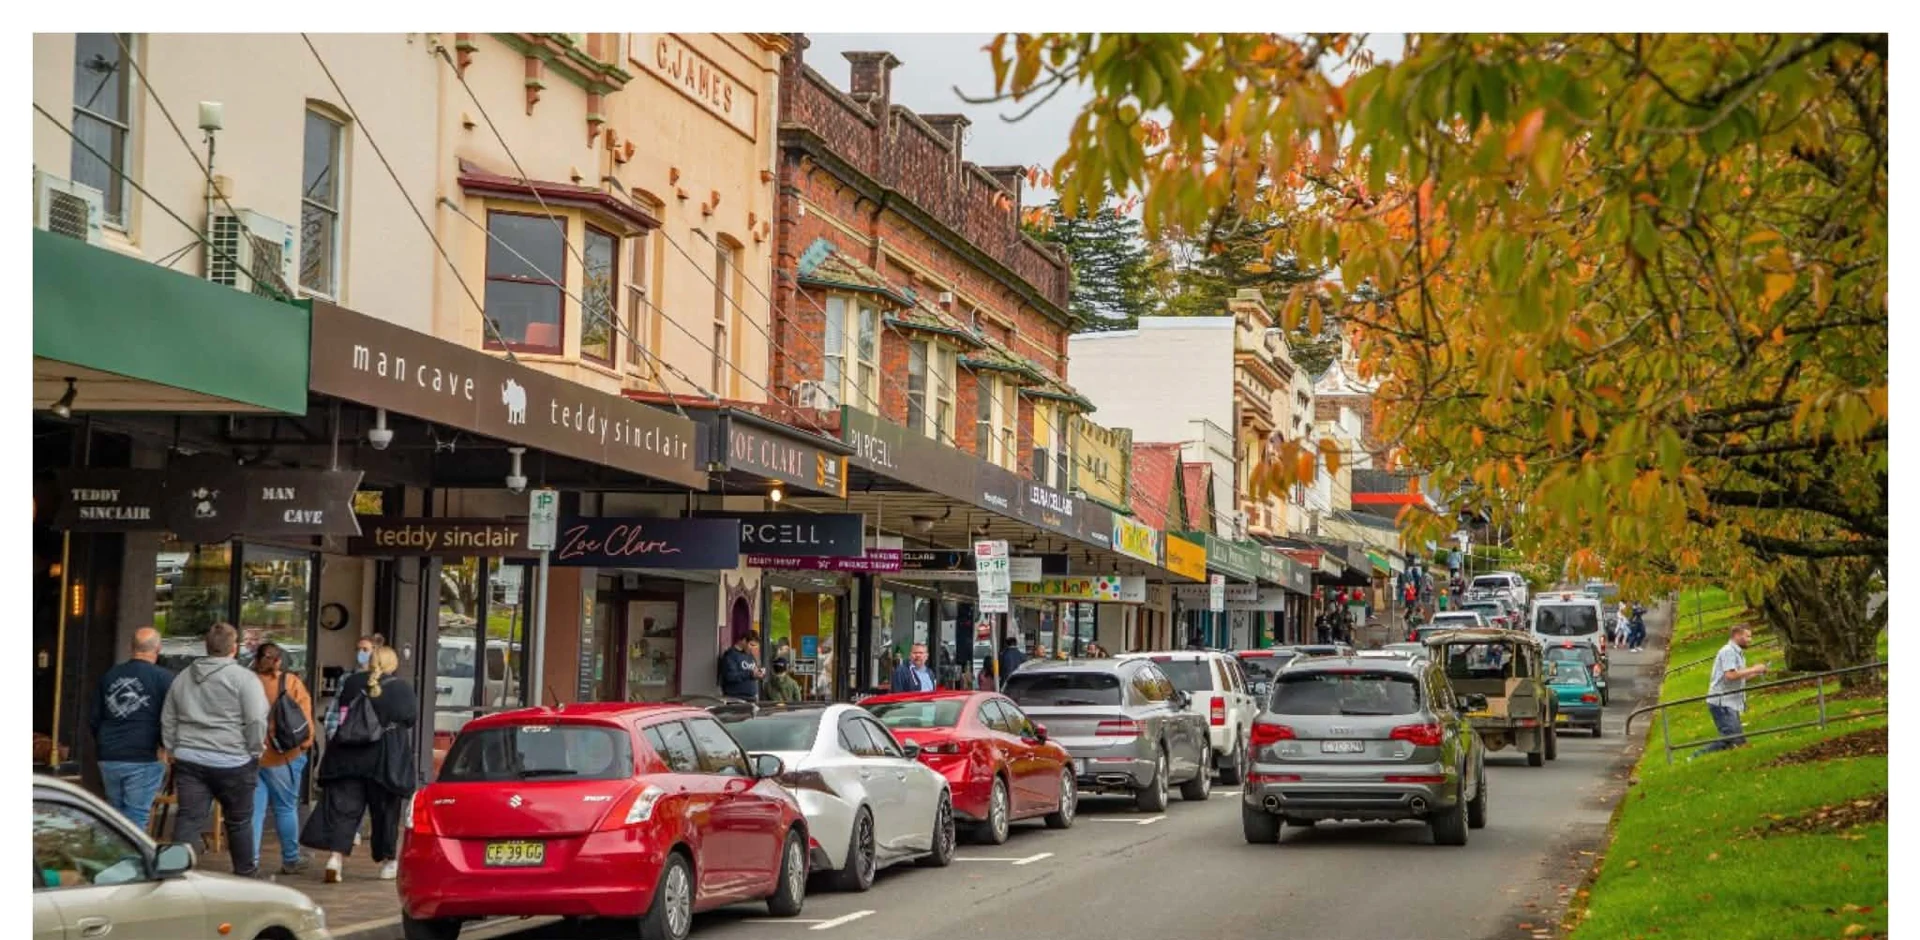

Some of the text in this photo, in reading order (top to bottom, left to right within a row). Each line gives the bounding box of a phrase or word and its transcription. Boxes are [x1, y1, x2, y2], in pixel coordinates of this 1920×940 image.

[353, 344, 475, 401] man cave
[550, 398, 688, 460] teddy sinclair
[71, 488, 121, 502] TEDDY
[262, 486, 296, 501] MAN
[79, 506, 151, 521] SINCLAIR
[283, 509, 323, 524] CAVE
[375, 524, 519, 551] teddy sinclair
[558, 524, 601, 560] Zoe
[487, 845, 543, 861] CE 39 GG
